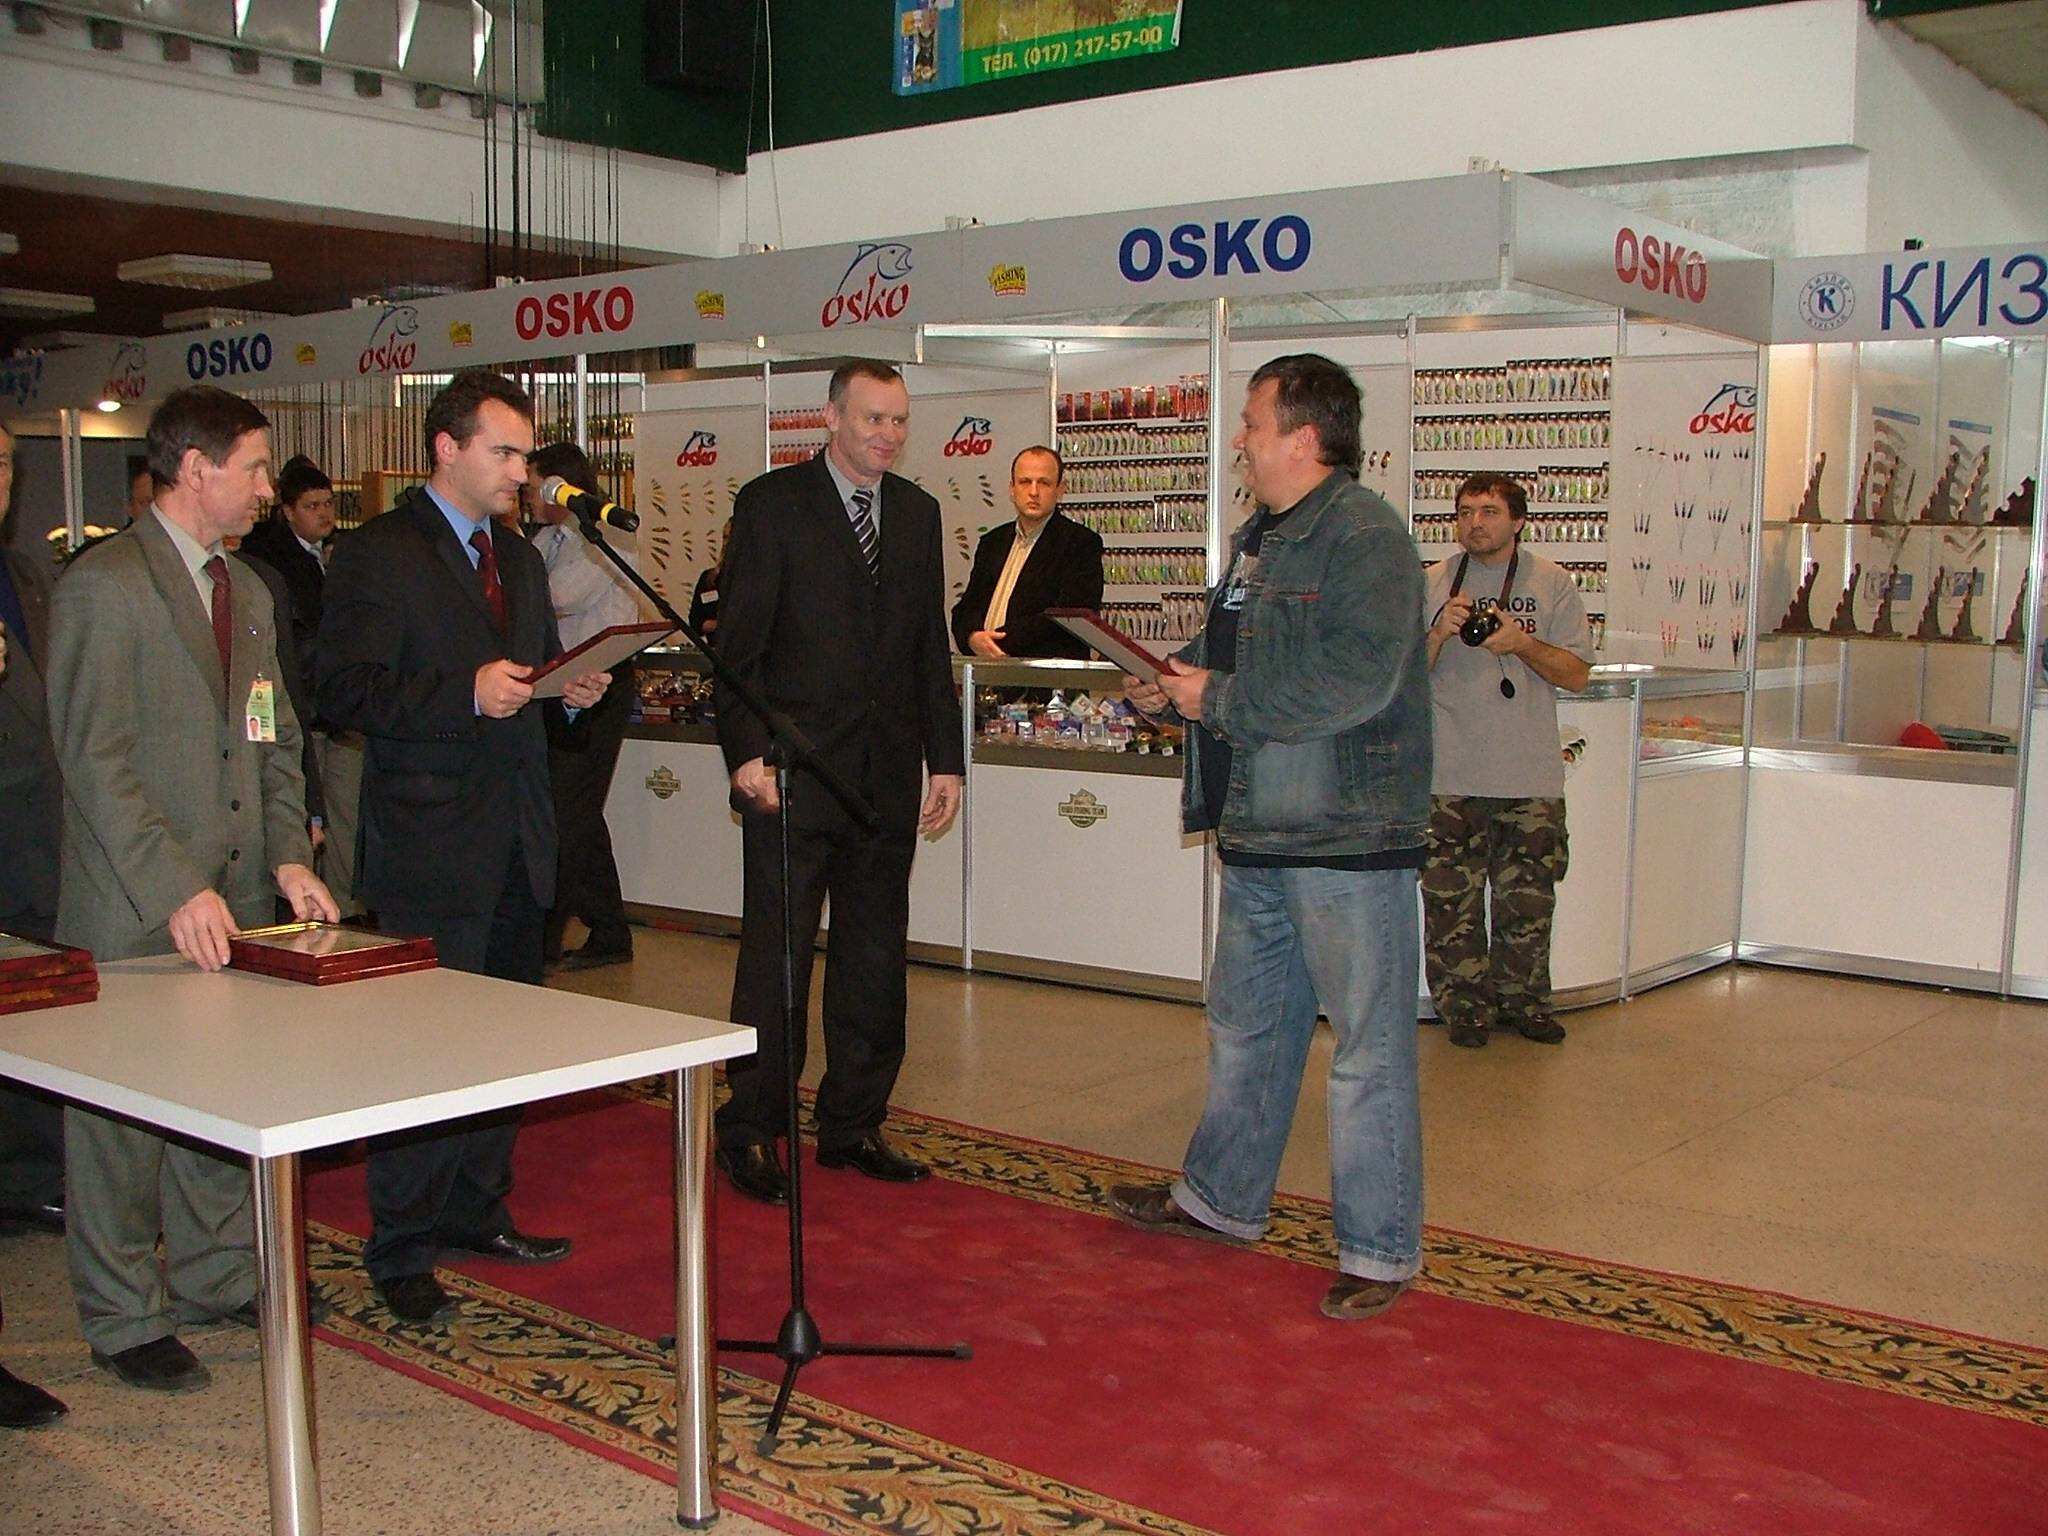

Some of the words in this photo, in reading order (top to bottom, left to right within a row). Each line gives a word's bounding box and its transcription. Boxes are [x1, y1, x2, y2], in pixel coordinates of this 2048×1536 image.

[982, 52, 1018, 73] ТЕЛ.
[1024, 42, 1068, 69] (017)
[1074, 26, 1163, 58] 217-57-00
[1118, 214, 1312, 283] OSKO
[1615, 227, 1707, 304] OSKO
[515, 286, 634, 341] OSKO
[821, 272, 910, 328] osko
[186, 333, 272, 380] OSKO
[358, 331, 416, 375] osko
[676, 446, 718, 467] osko
[943, 431, 993, 457] osko
